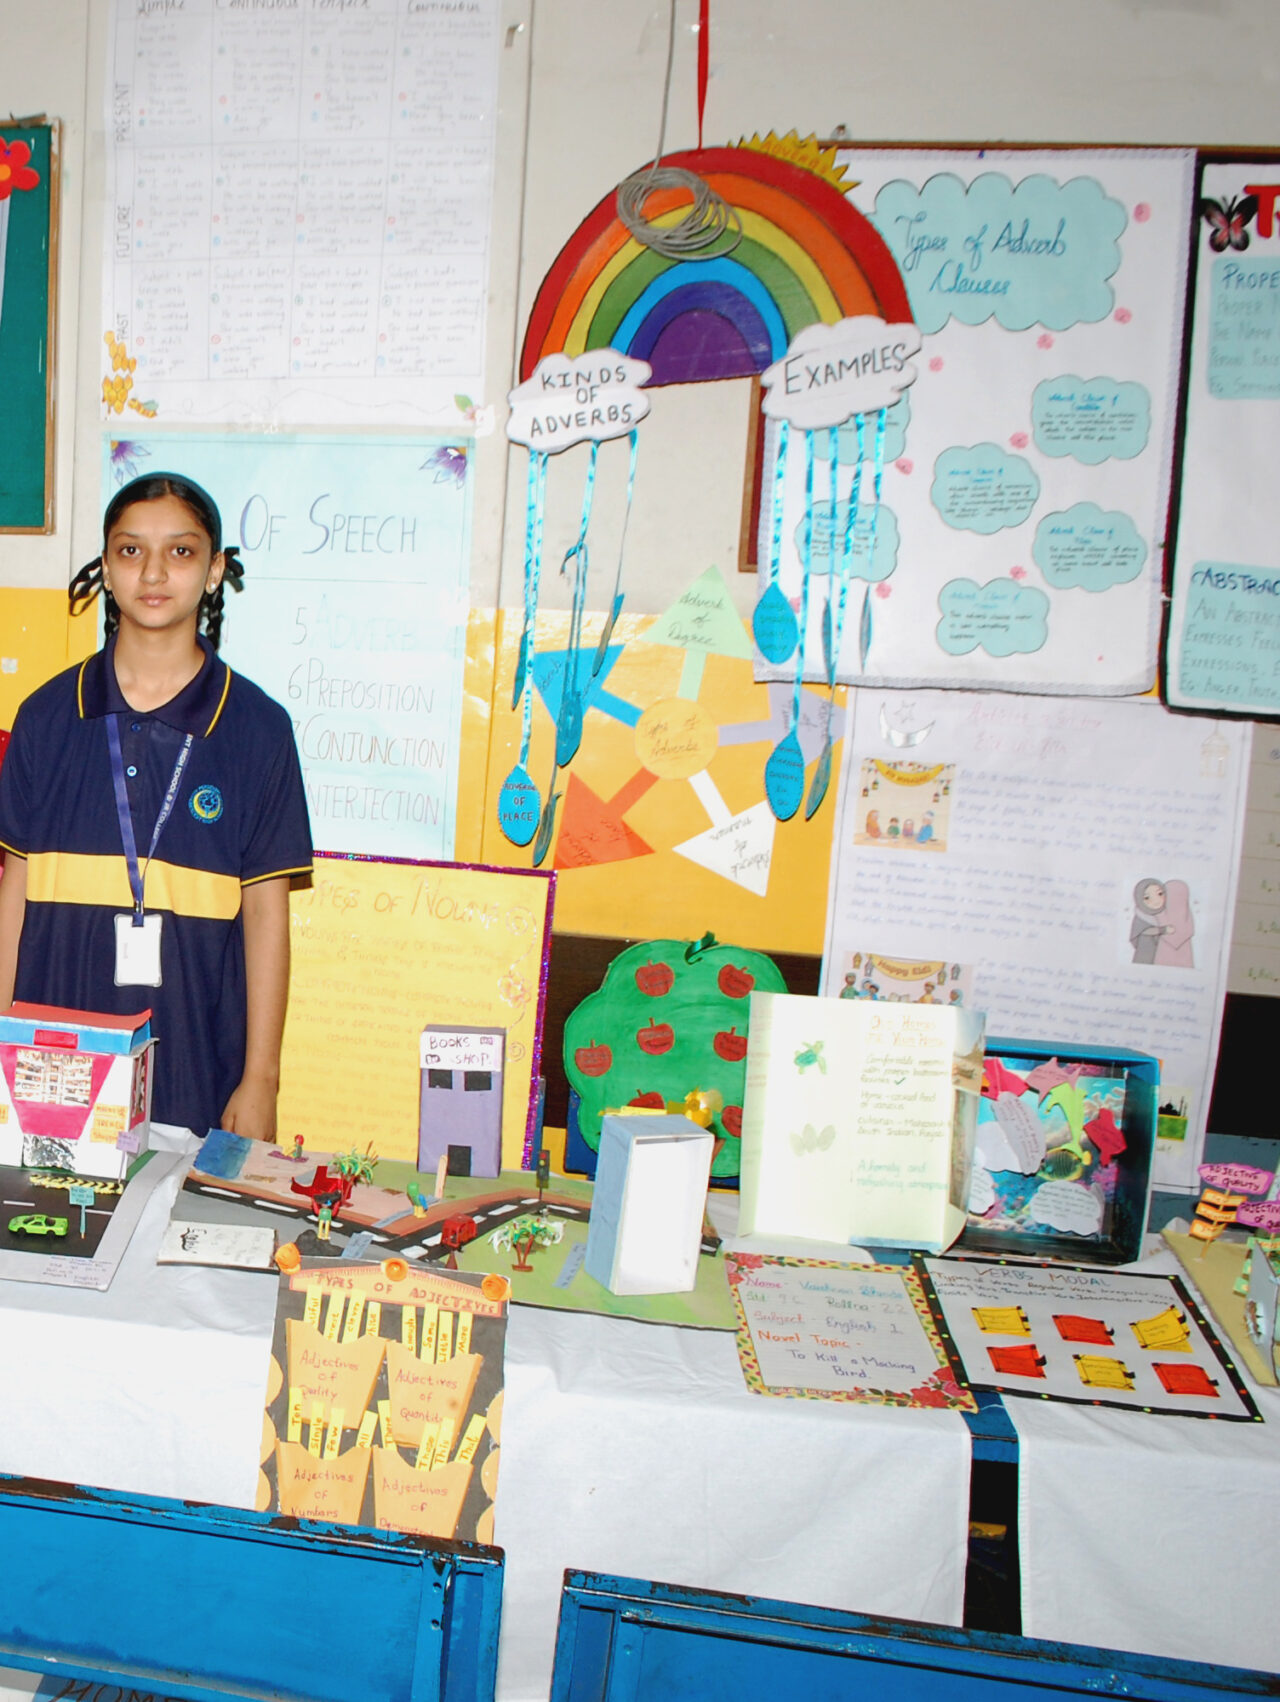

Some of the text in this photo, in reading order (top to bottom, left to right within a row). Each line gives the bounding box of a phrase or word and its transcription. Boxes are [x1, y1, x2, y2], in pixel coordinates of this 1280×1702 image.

[116, 204, 130, 259] FUTURE
[894, 211, 1066, 272] Types of Adverb
[116, 312, 129, 340] PAST
[541, 367, 627, 389] KINDS
[784, 343, 908, 395] EXAMPLES
[576, 386, 599, 404] OF
[530, 404, 633, 438] ADVERBS
[239, 493, 417, 554] OF SPEECH
[292, 606, 307, 645] 5
[288, 657, 435, 714] 6 PREPOSITION
[301, 713, 446, 769] CONJUNCTION
[177, 747, 190, 766] HIGH
[168, 766, 182, 794] SCHOOL
[513, 796, 527, 806] OF
[502, 811, 534, 822] PLACE
[374, 892, 404, 914] OF
[877, 960, 909, 977] Happy
[429, 1035, 471, 1050] BOOKS
[1223, 1177, 1260, 1191] QUALITY
[973, 1265, 1112, 1287] VERBS MODAL
[315, 1274, 495, 1314] TYPES OF ADJECTIVES
[826, 1315, 878, 1335] English
[758, 1330, 851, 1349] Novel Topic
[300, 1350, 360, 1372] Adjectives
[784, 1348, 917, 1374] To Kill Mocking
[318, 1371, 337, 1381] of
[395, 1372, 458, 1389] Adjectives
[420, 1391, 432, 1401] of
[291, 1403, 302, 1426] Ten
[310, 1416, 322, 1450] Single
[327, 1427, 338, 1452] Few
[360, 1432, 370, 1448] All
[294, 1468, 354, 1483] Adjectives
[314, 1490, 328, 1500] of
[382, 1478, 448, 1496] Adjectives
[411, 1502, 428, 1512] of
